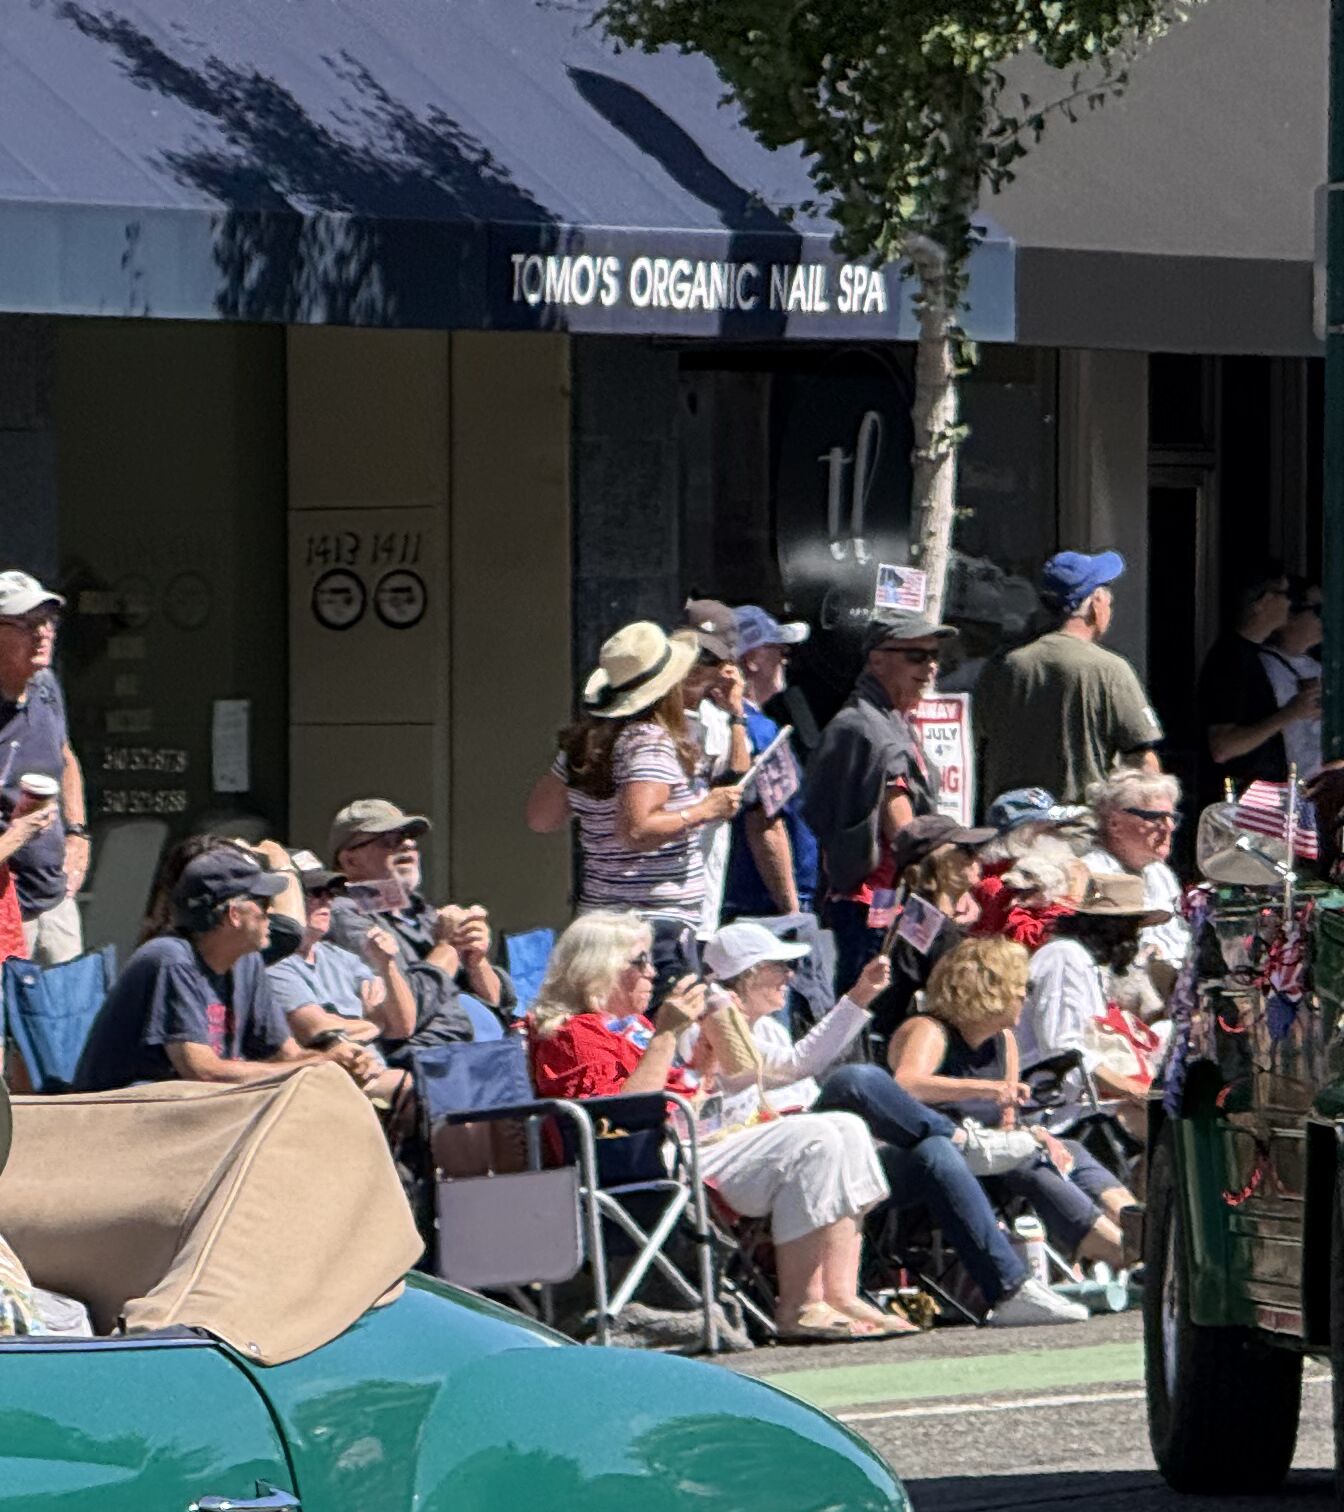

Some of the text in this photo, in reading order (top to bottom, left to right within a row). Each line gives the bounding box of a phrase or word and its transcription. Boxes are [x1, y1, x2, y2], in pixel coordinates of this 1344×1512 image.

[511, 253, 887, 314] TOMO'S ORGANIC NAIL SPA
[926, 727, 958, 741] JULY
